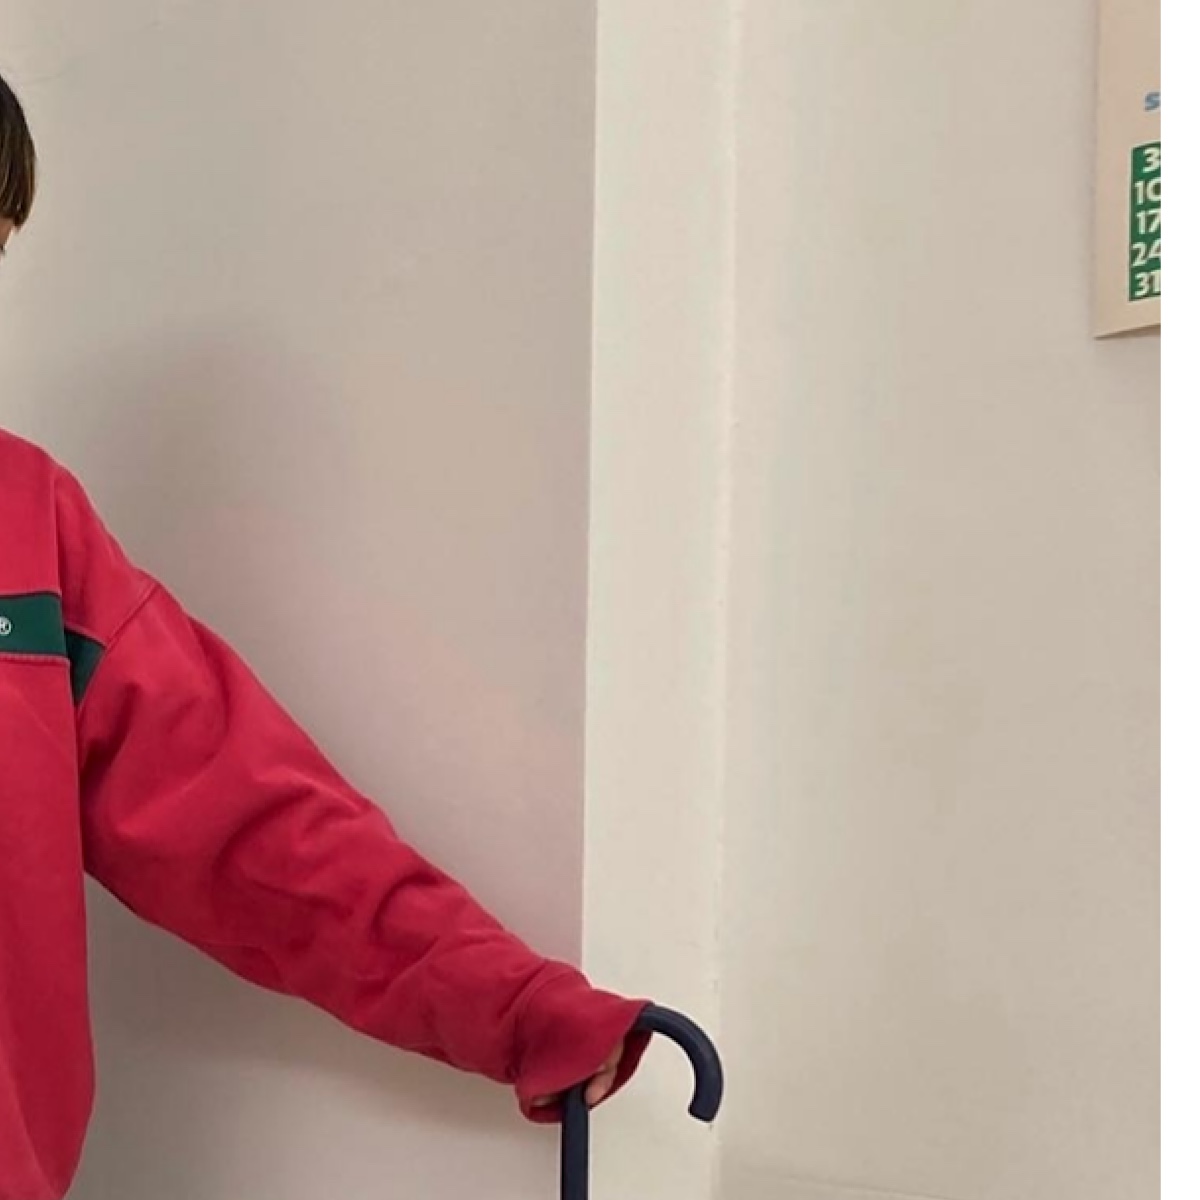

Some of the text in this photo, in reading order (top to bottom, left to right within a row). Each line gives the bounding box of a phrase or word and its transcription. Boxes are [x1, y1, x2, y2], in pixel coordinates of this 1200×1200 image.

[1142, 147, 1161, 174] 3
[1134, 177, 1161, 205] 10
[1136, 209, 1161, 235] 17
[1134, 270, 1161, 297] 31
